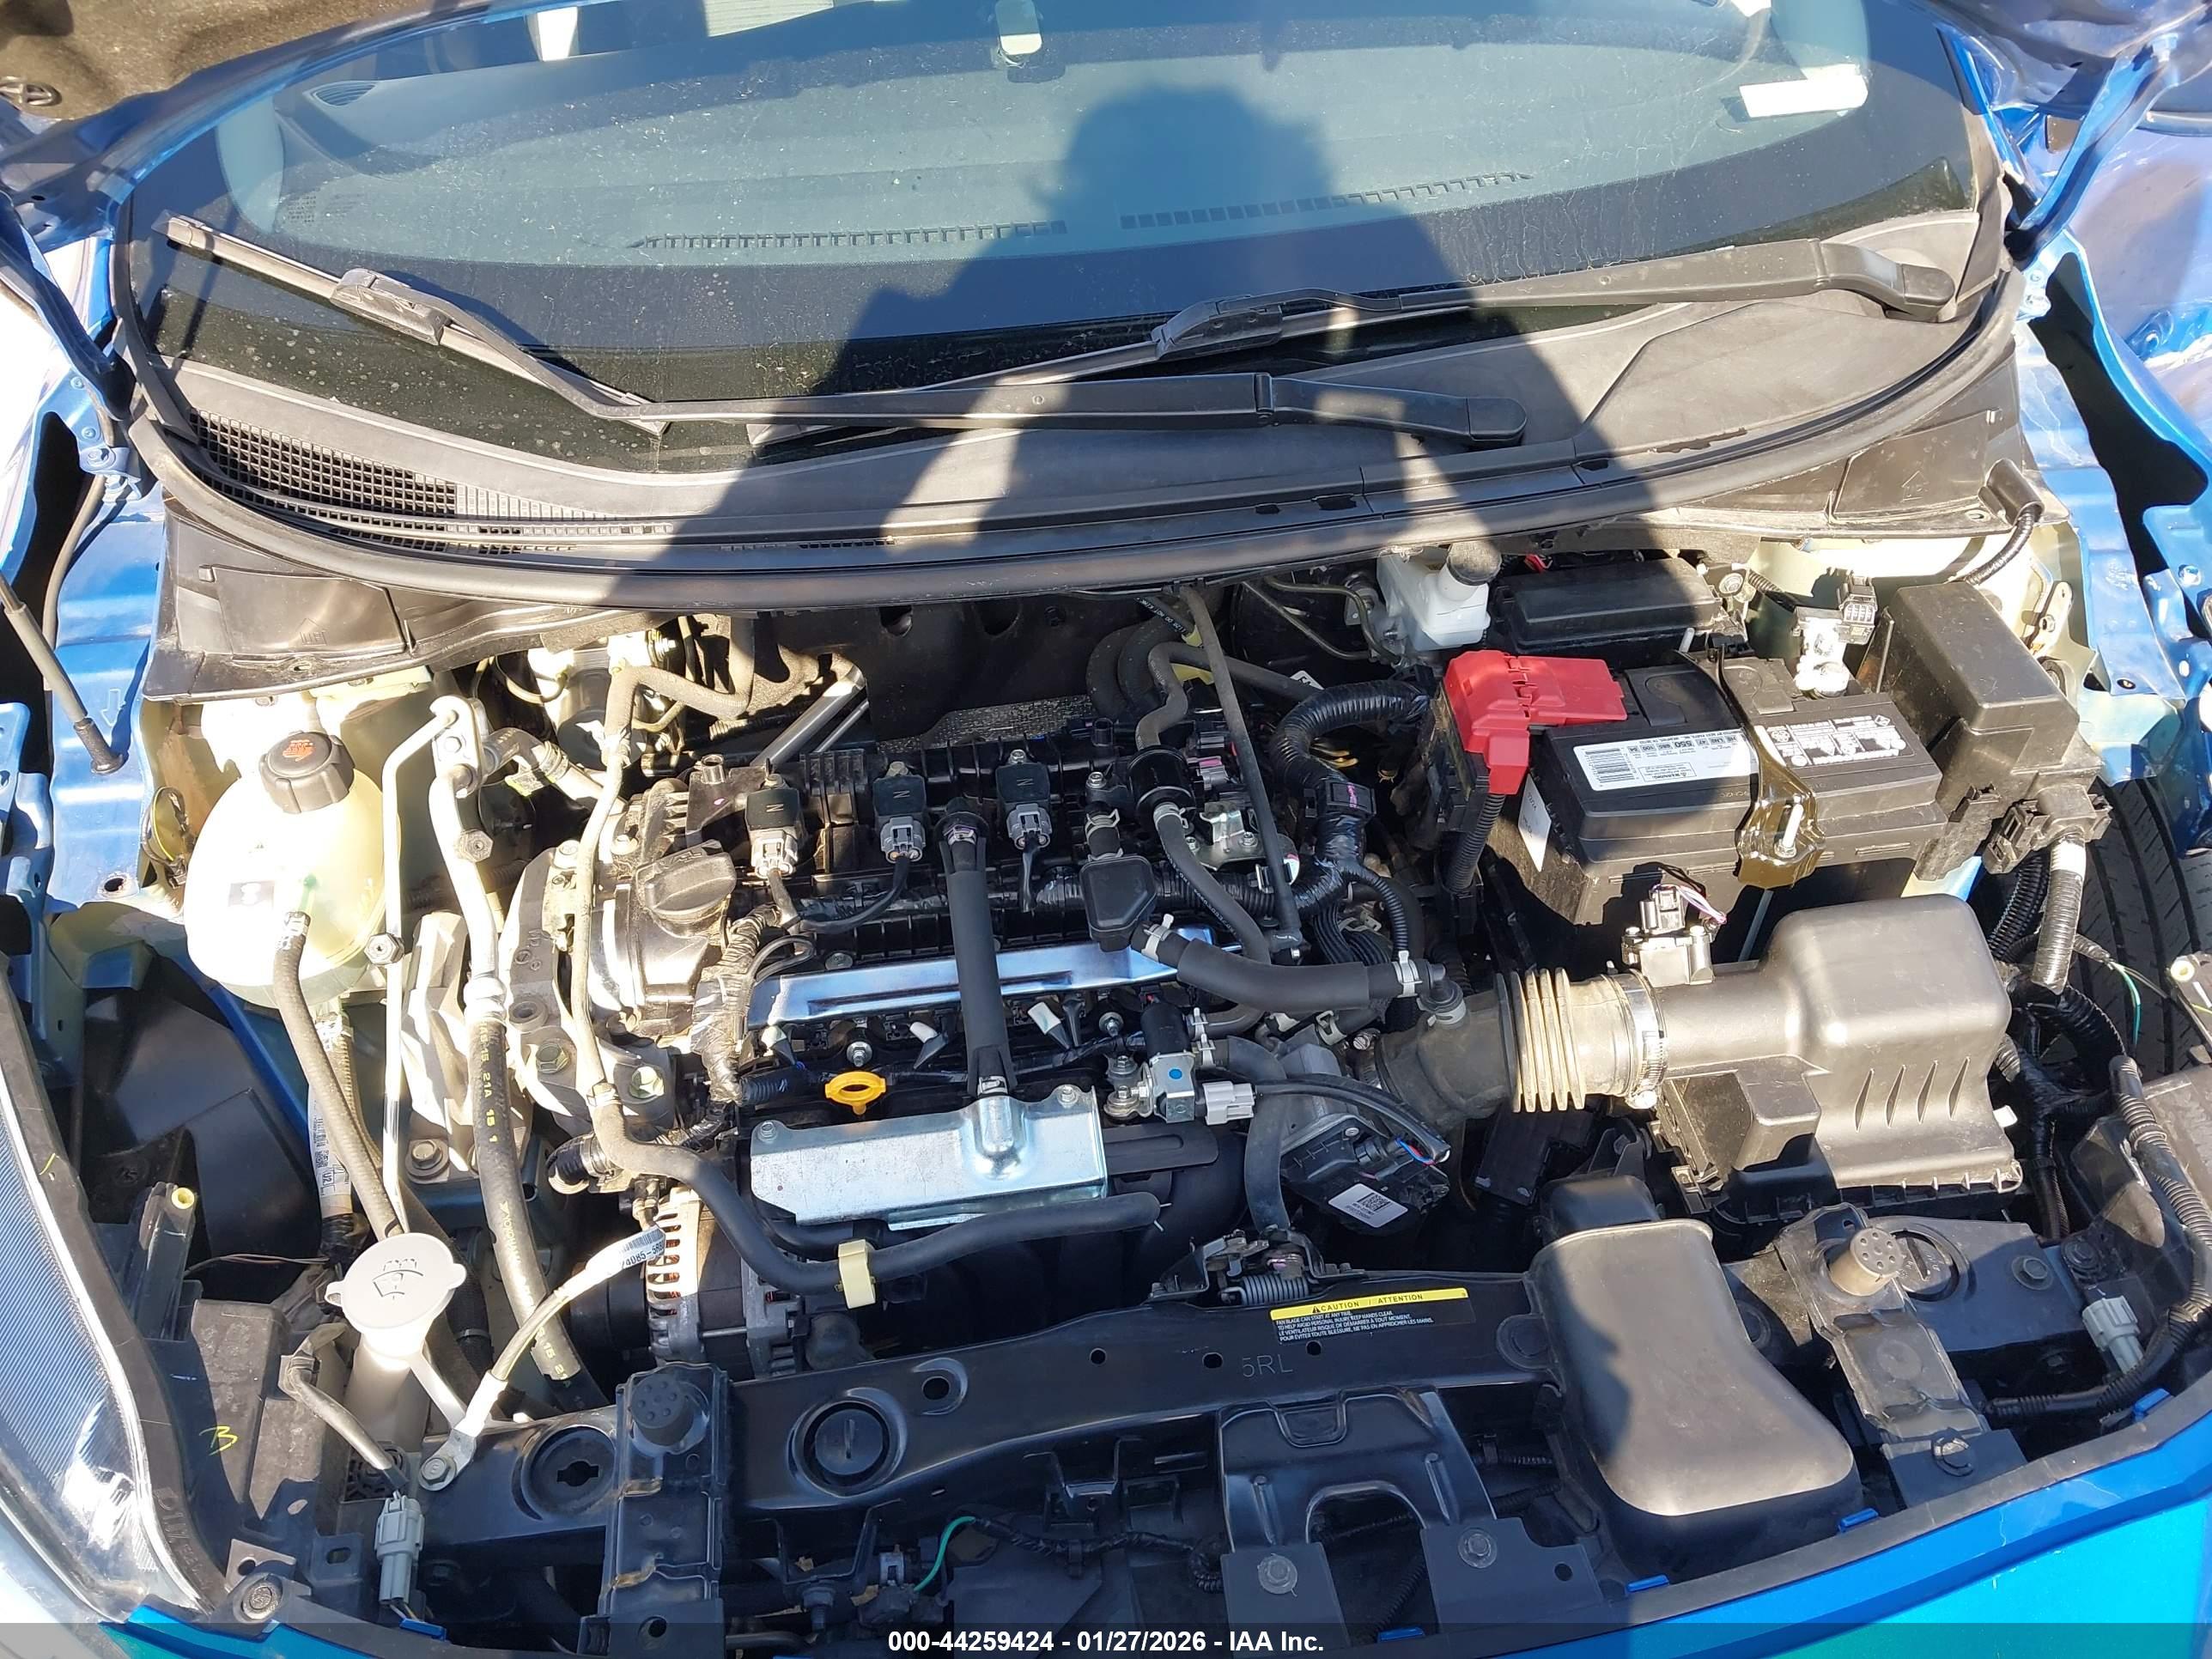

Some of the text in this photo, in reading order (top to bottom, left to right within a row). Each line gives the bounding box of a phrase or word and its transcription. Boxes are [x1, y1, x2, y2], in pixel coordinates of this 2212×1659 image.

[481, 1072, 493, 1097] 21A
[1321, 1302, 1359, 1312] CAUTION
[1377, 1293, 1423, 1304] ATTENTION
[1242, 1354, 1293, 1377] 5RL
